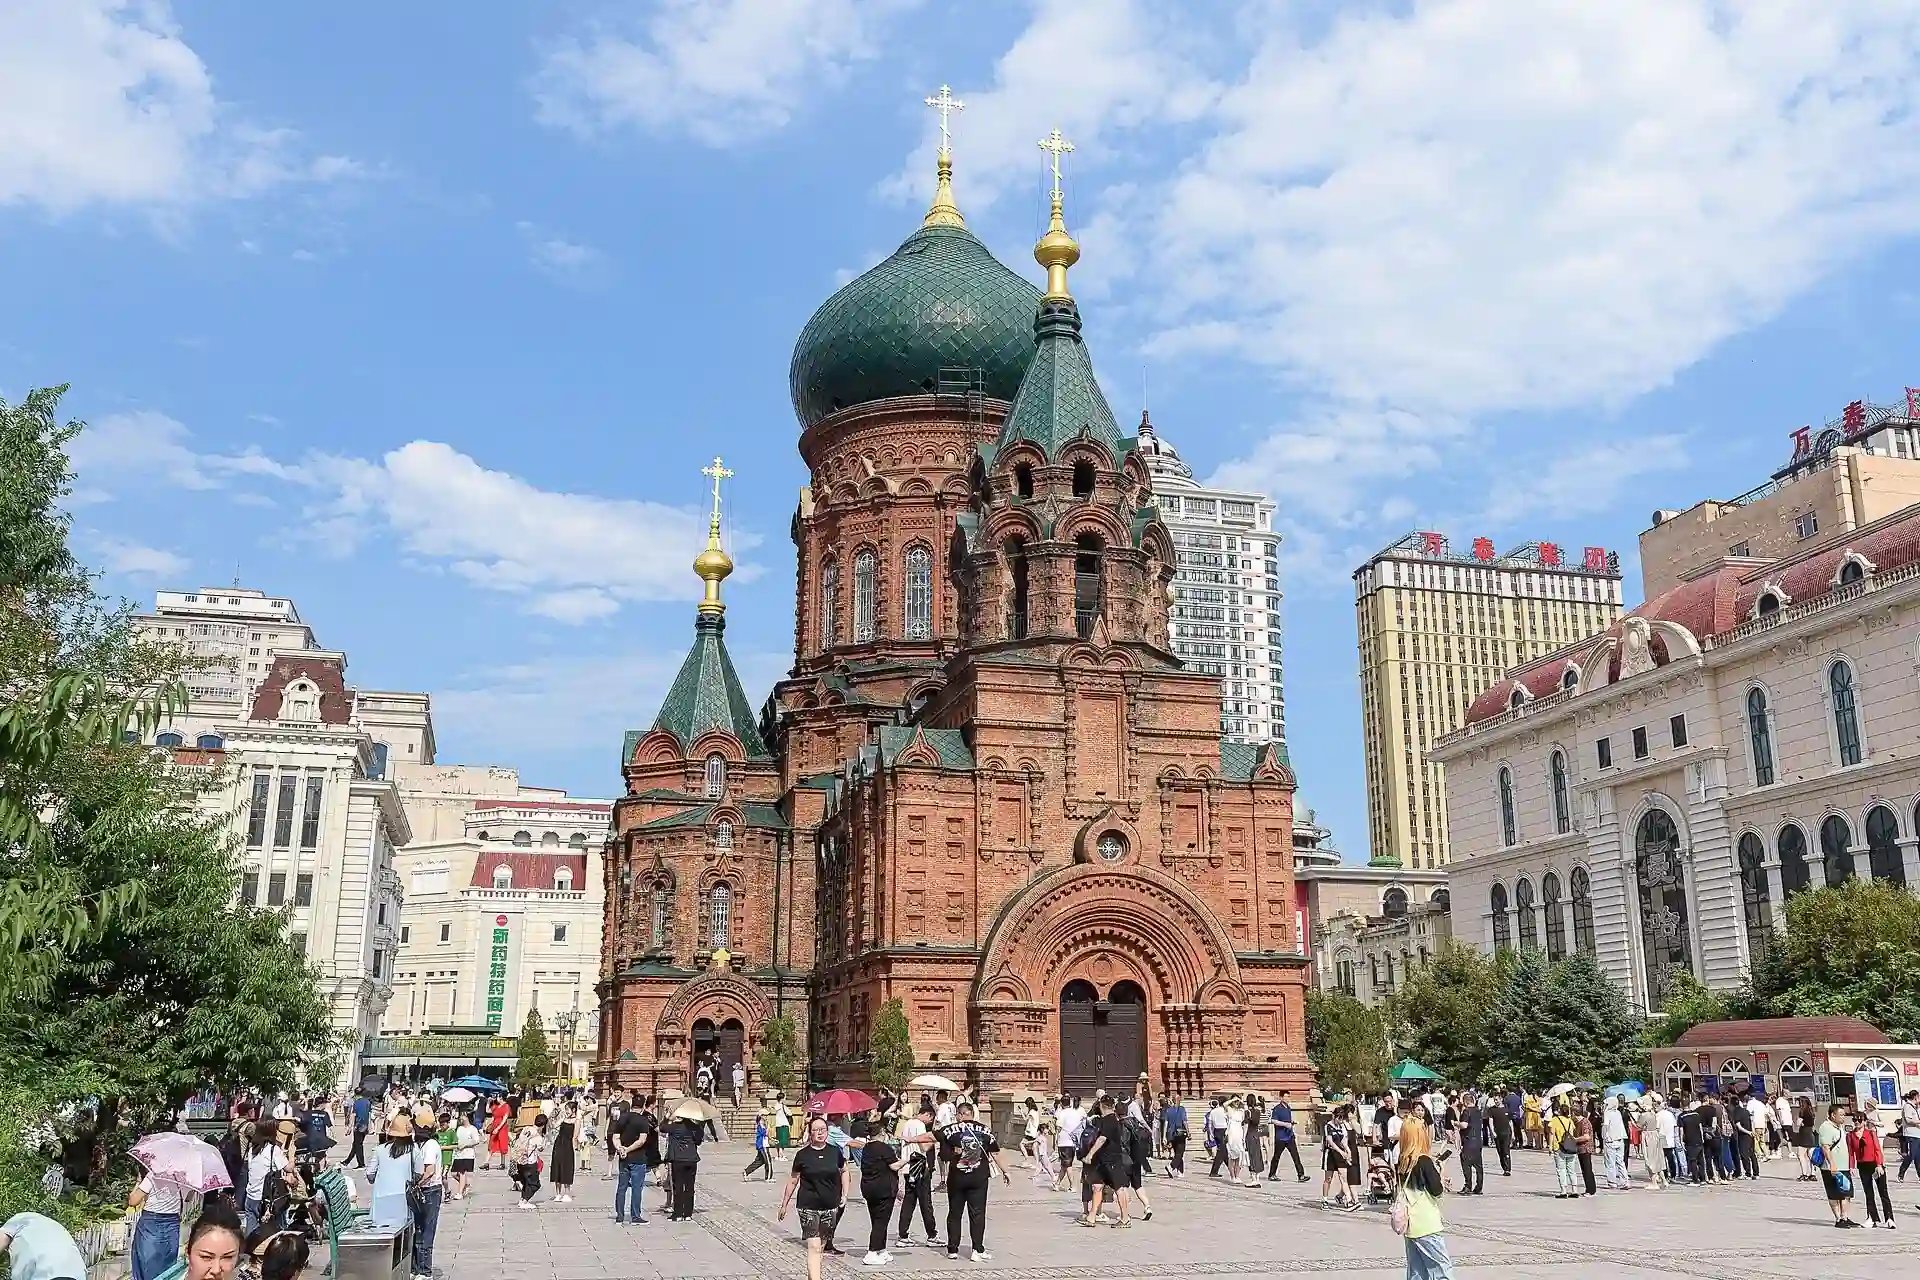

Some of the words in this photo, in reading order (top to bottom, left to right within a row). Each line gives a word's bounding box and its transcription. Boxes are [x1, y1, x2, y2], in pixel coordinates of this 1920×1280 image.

[1417, 531, 1606, 571] 万泰集团
[486, 928, 509, 1026] 新药特药商店
